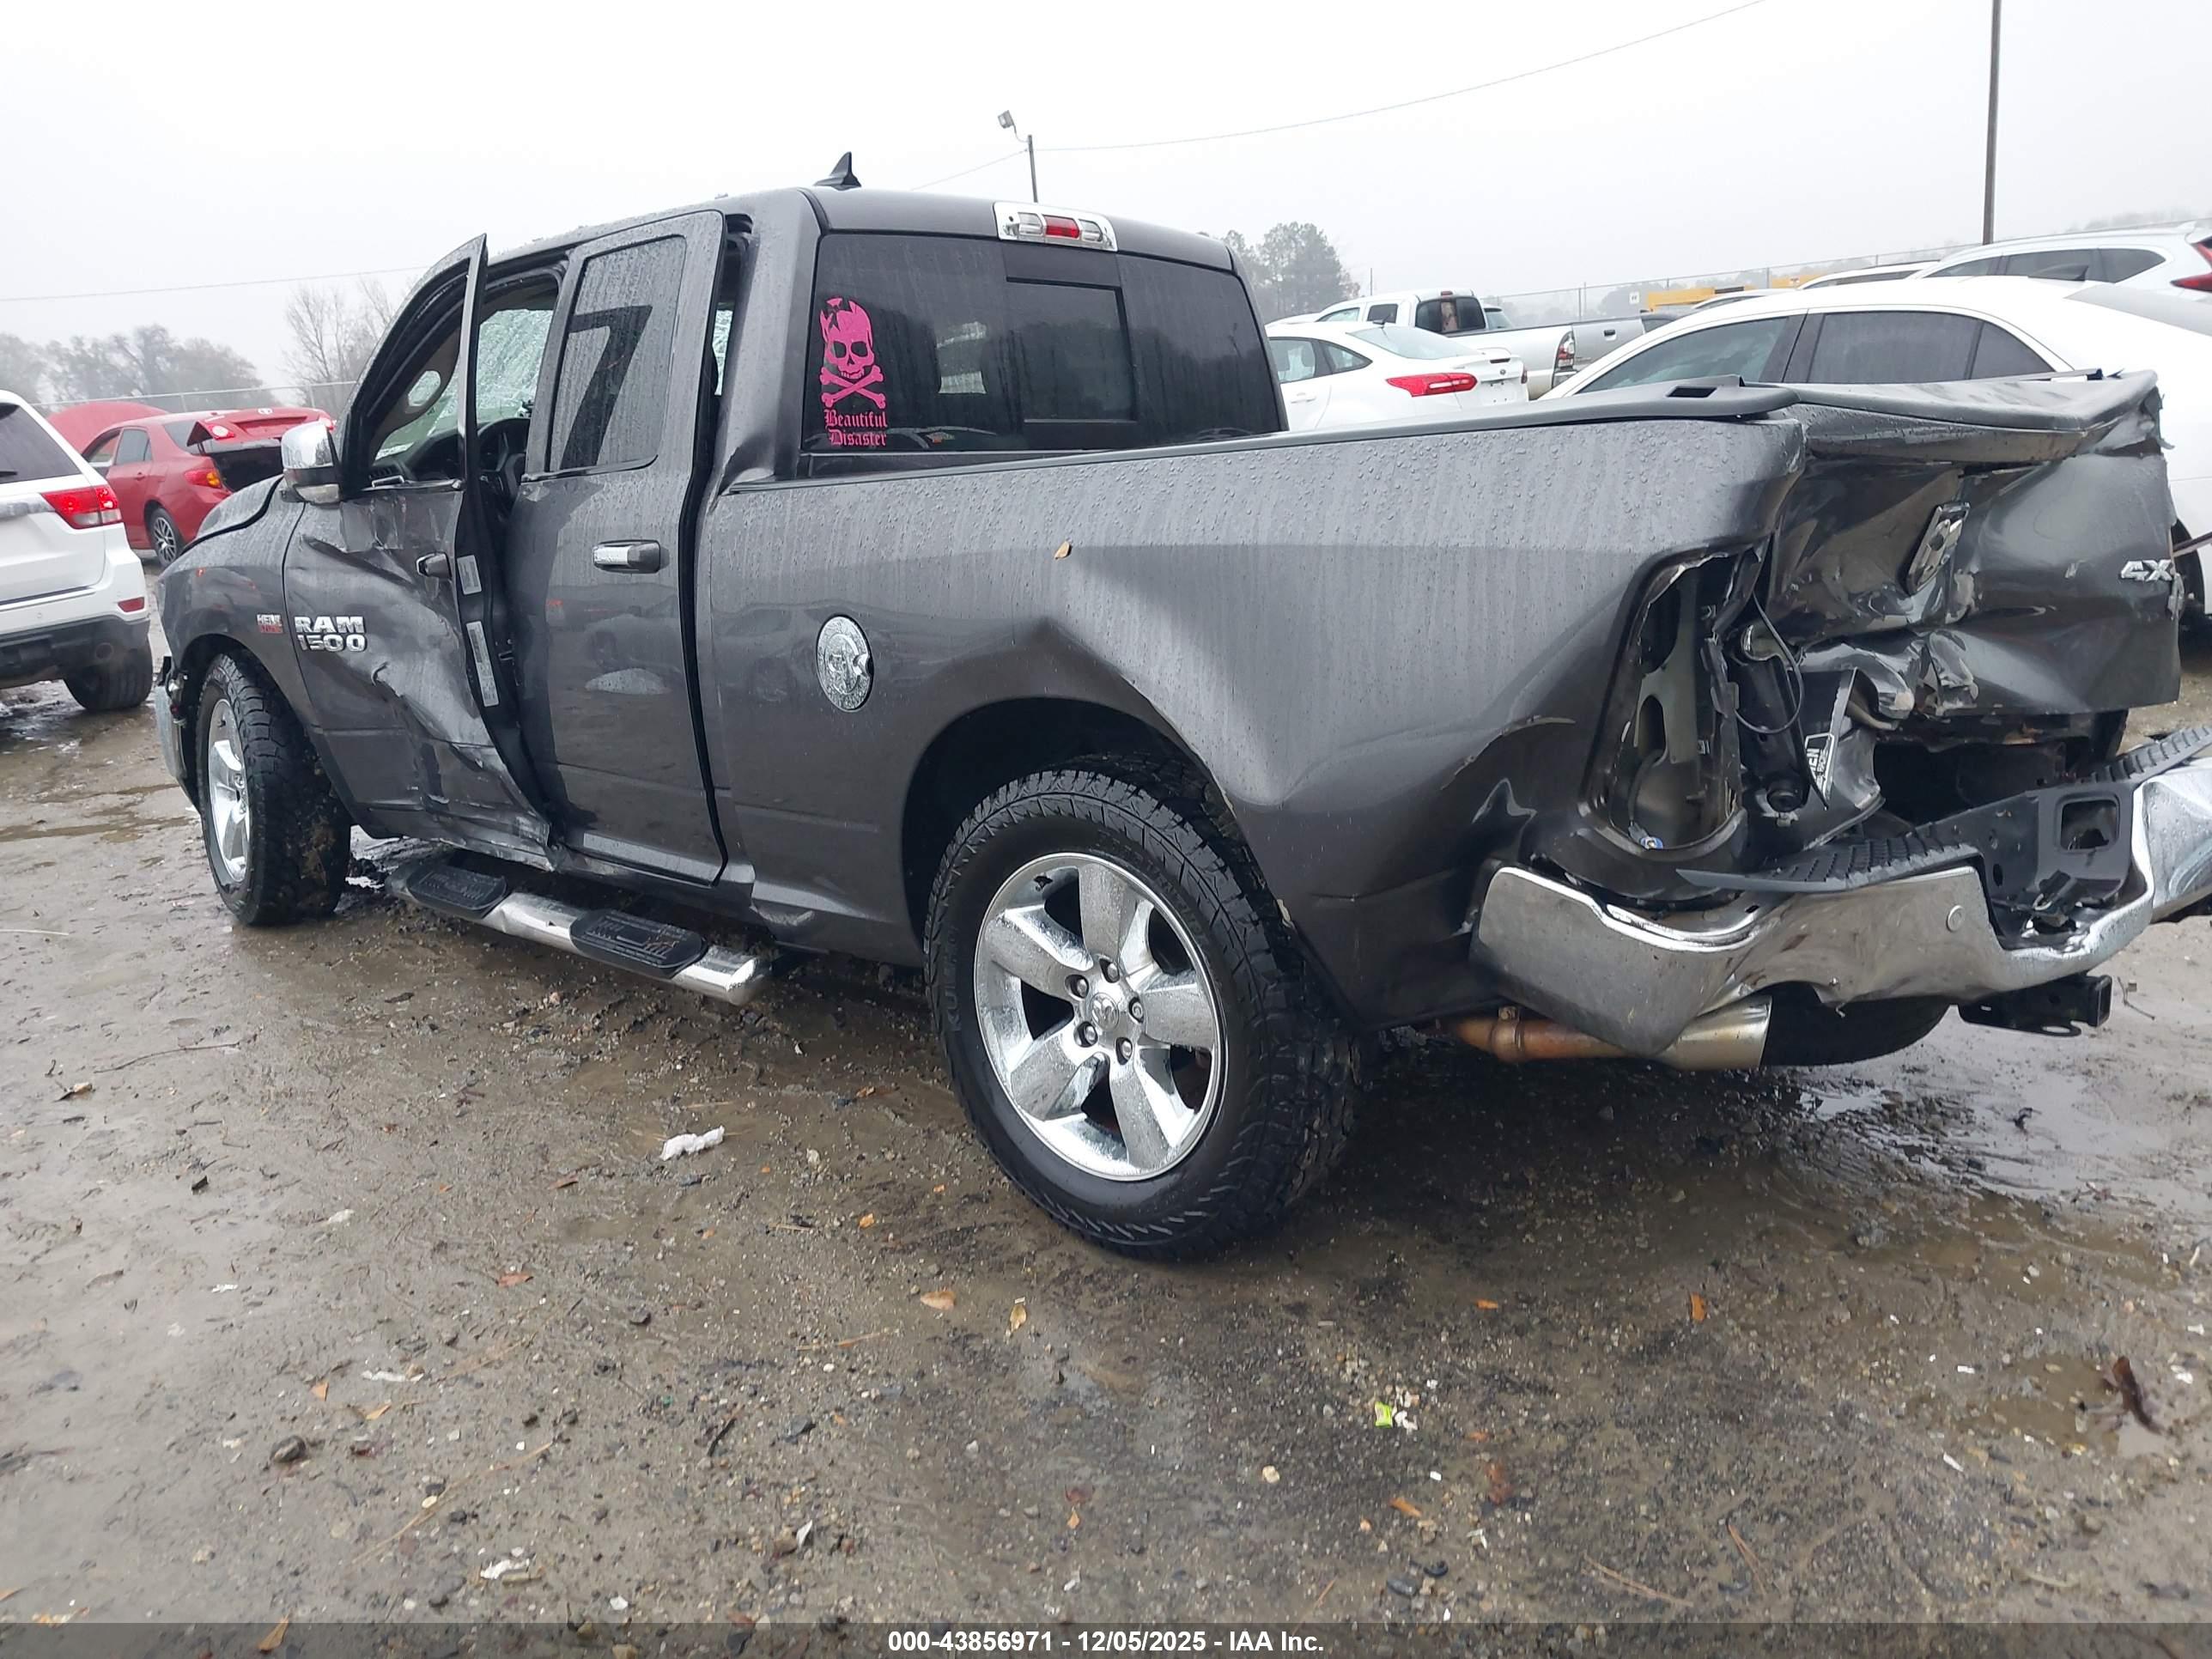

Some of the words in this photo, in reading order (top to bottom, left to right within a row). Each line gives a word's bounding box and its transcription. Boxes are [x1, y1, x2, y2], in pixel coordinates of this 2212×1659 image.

[823, 409, 888, 429] Beautiful
[828, 428, 886, 447] Disaster
[294, 616, 365, 634] RAM
[297, 634, 367, 652] 1500
